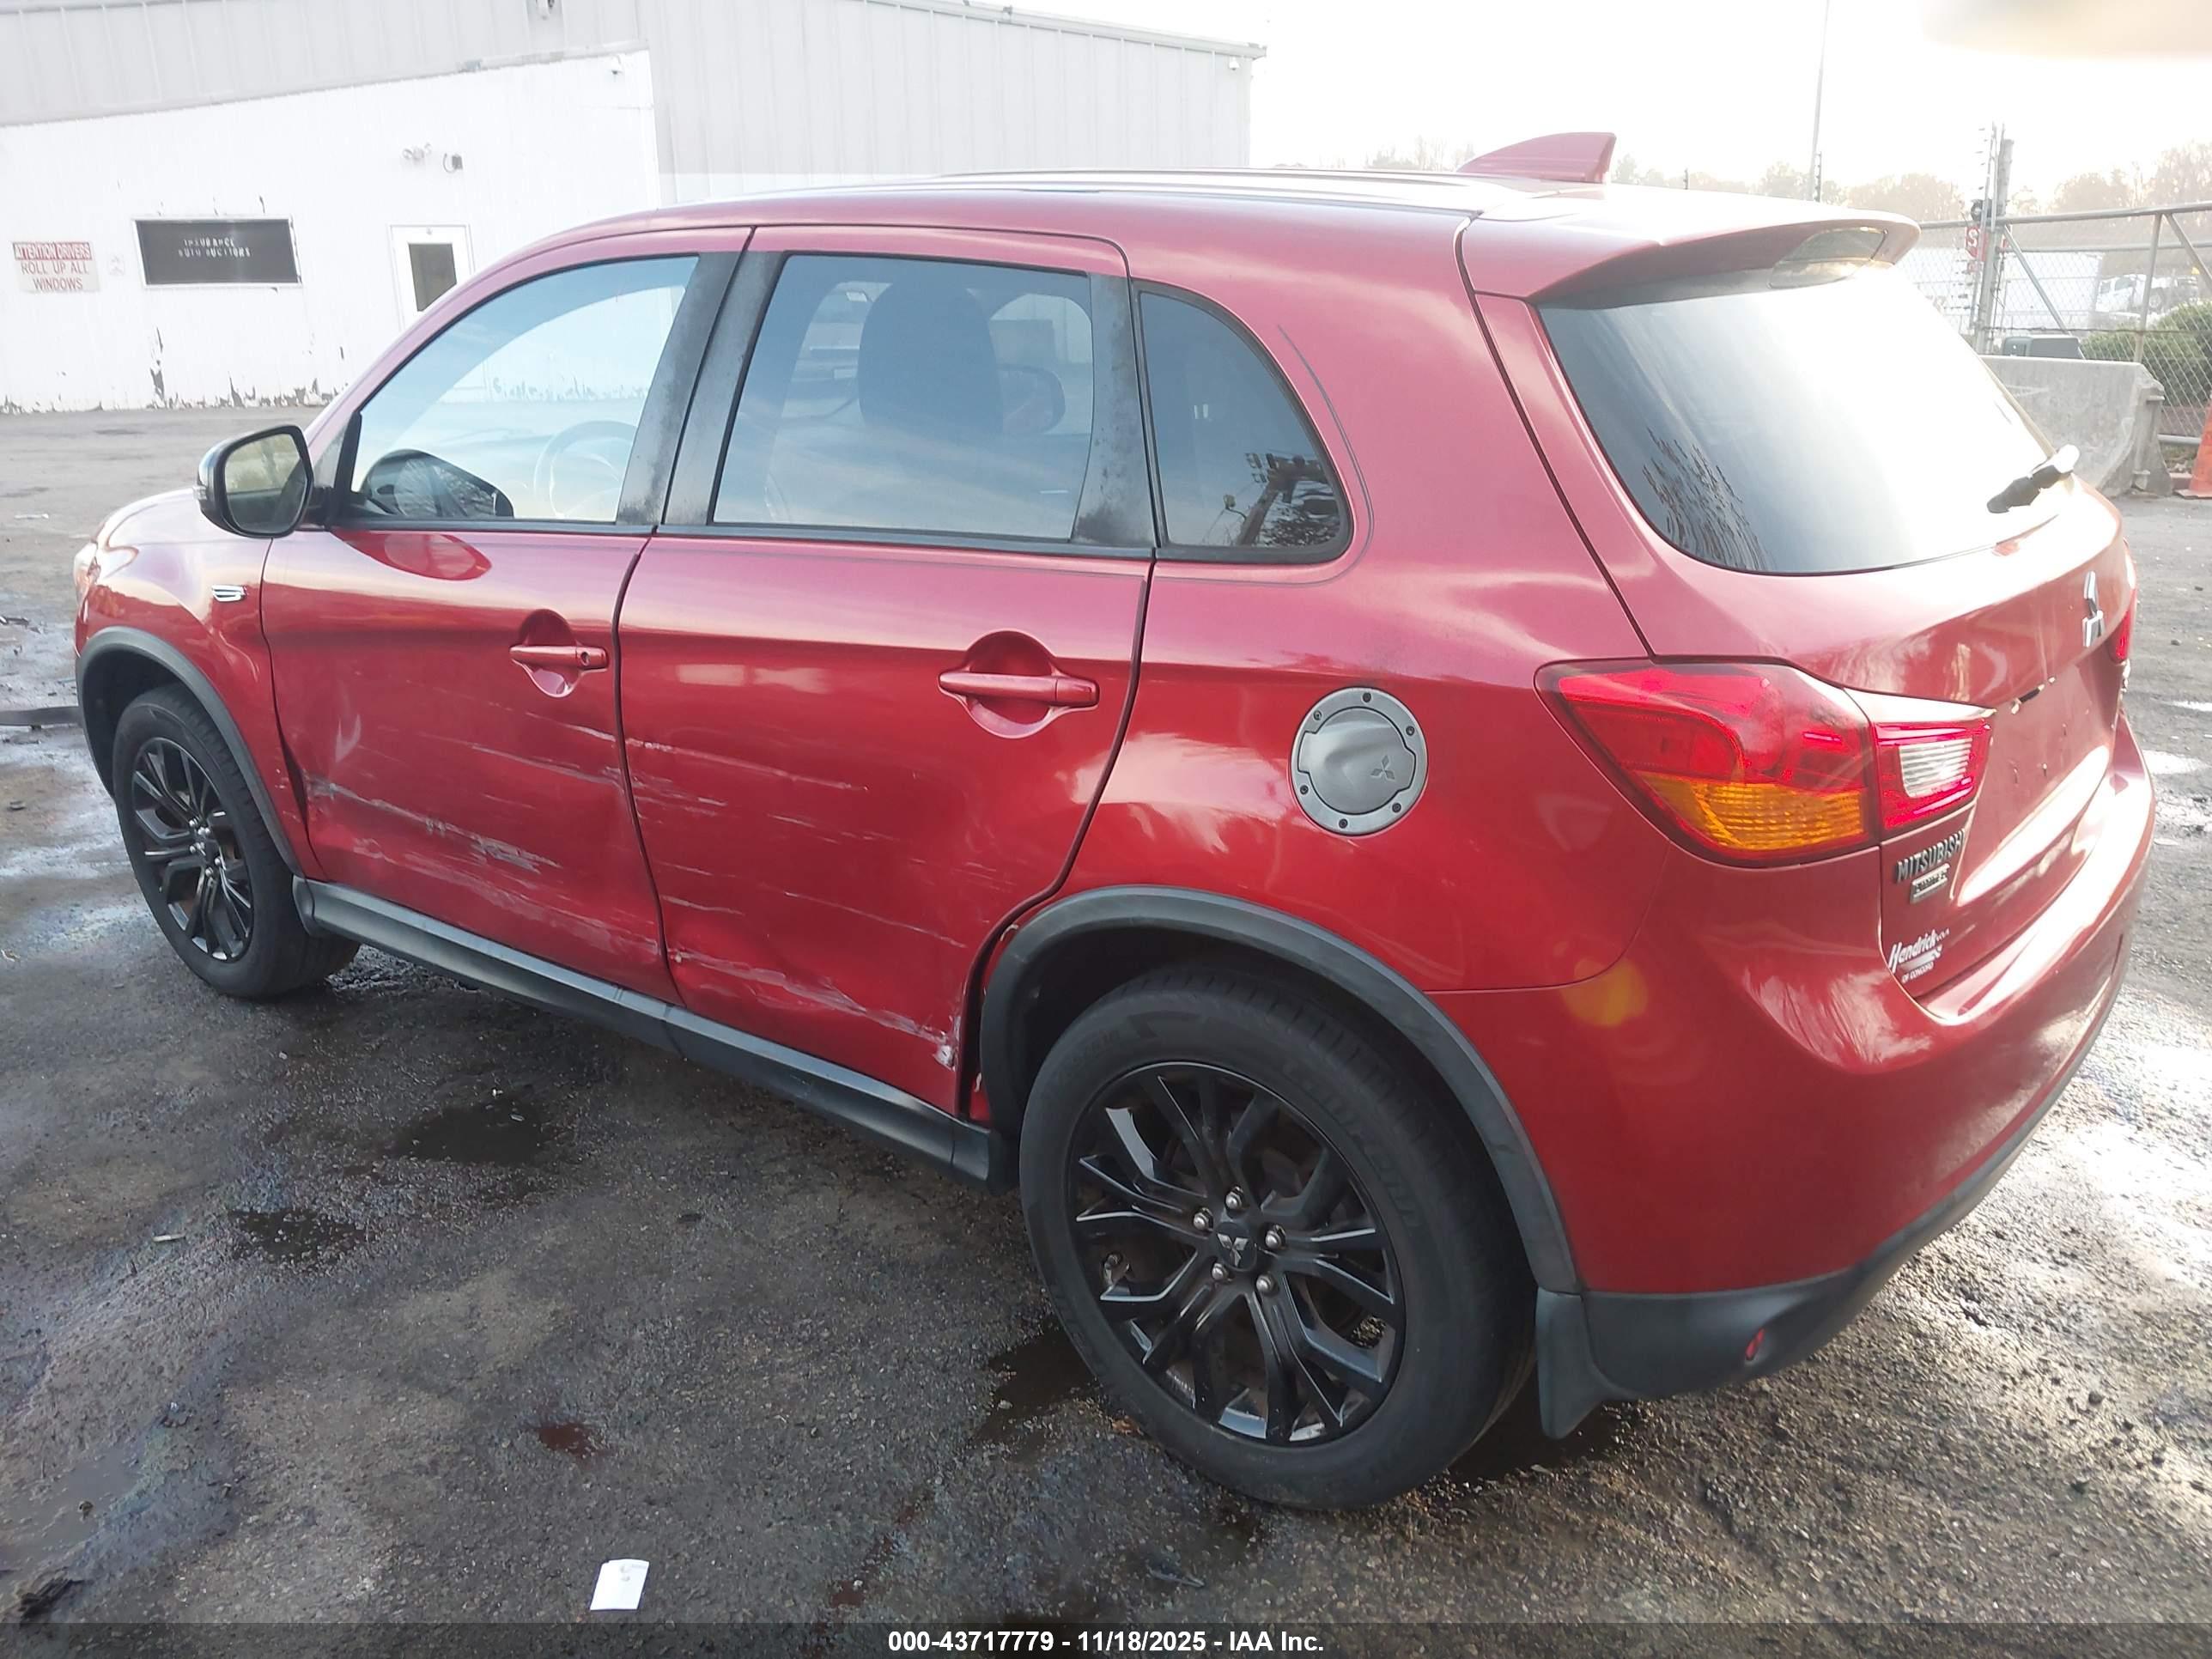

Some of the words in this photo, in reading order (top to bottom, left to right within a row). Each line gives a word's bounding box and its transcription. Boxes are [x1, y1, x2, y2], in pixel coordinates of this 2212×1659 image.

[14, 243, 57, 259] ATTENTION
[21, 260, 47, 275] ROLL
[52, 260, 66, 275] UP
[70, 260, 89, 275] ALL
[33, 277, 82, 292] WINDOWS
[1888, 929, 1937, 974] Hendrick
